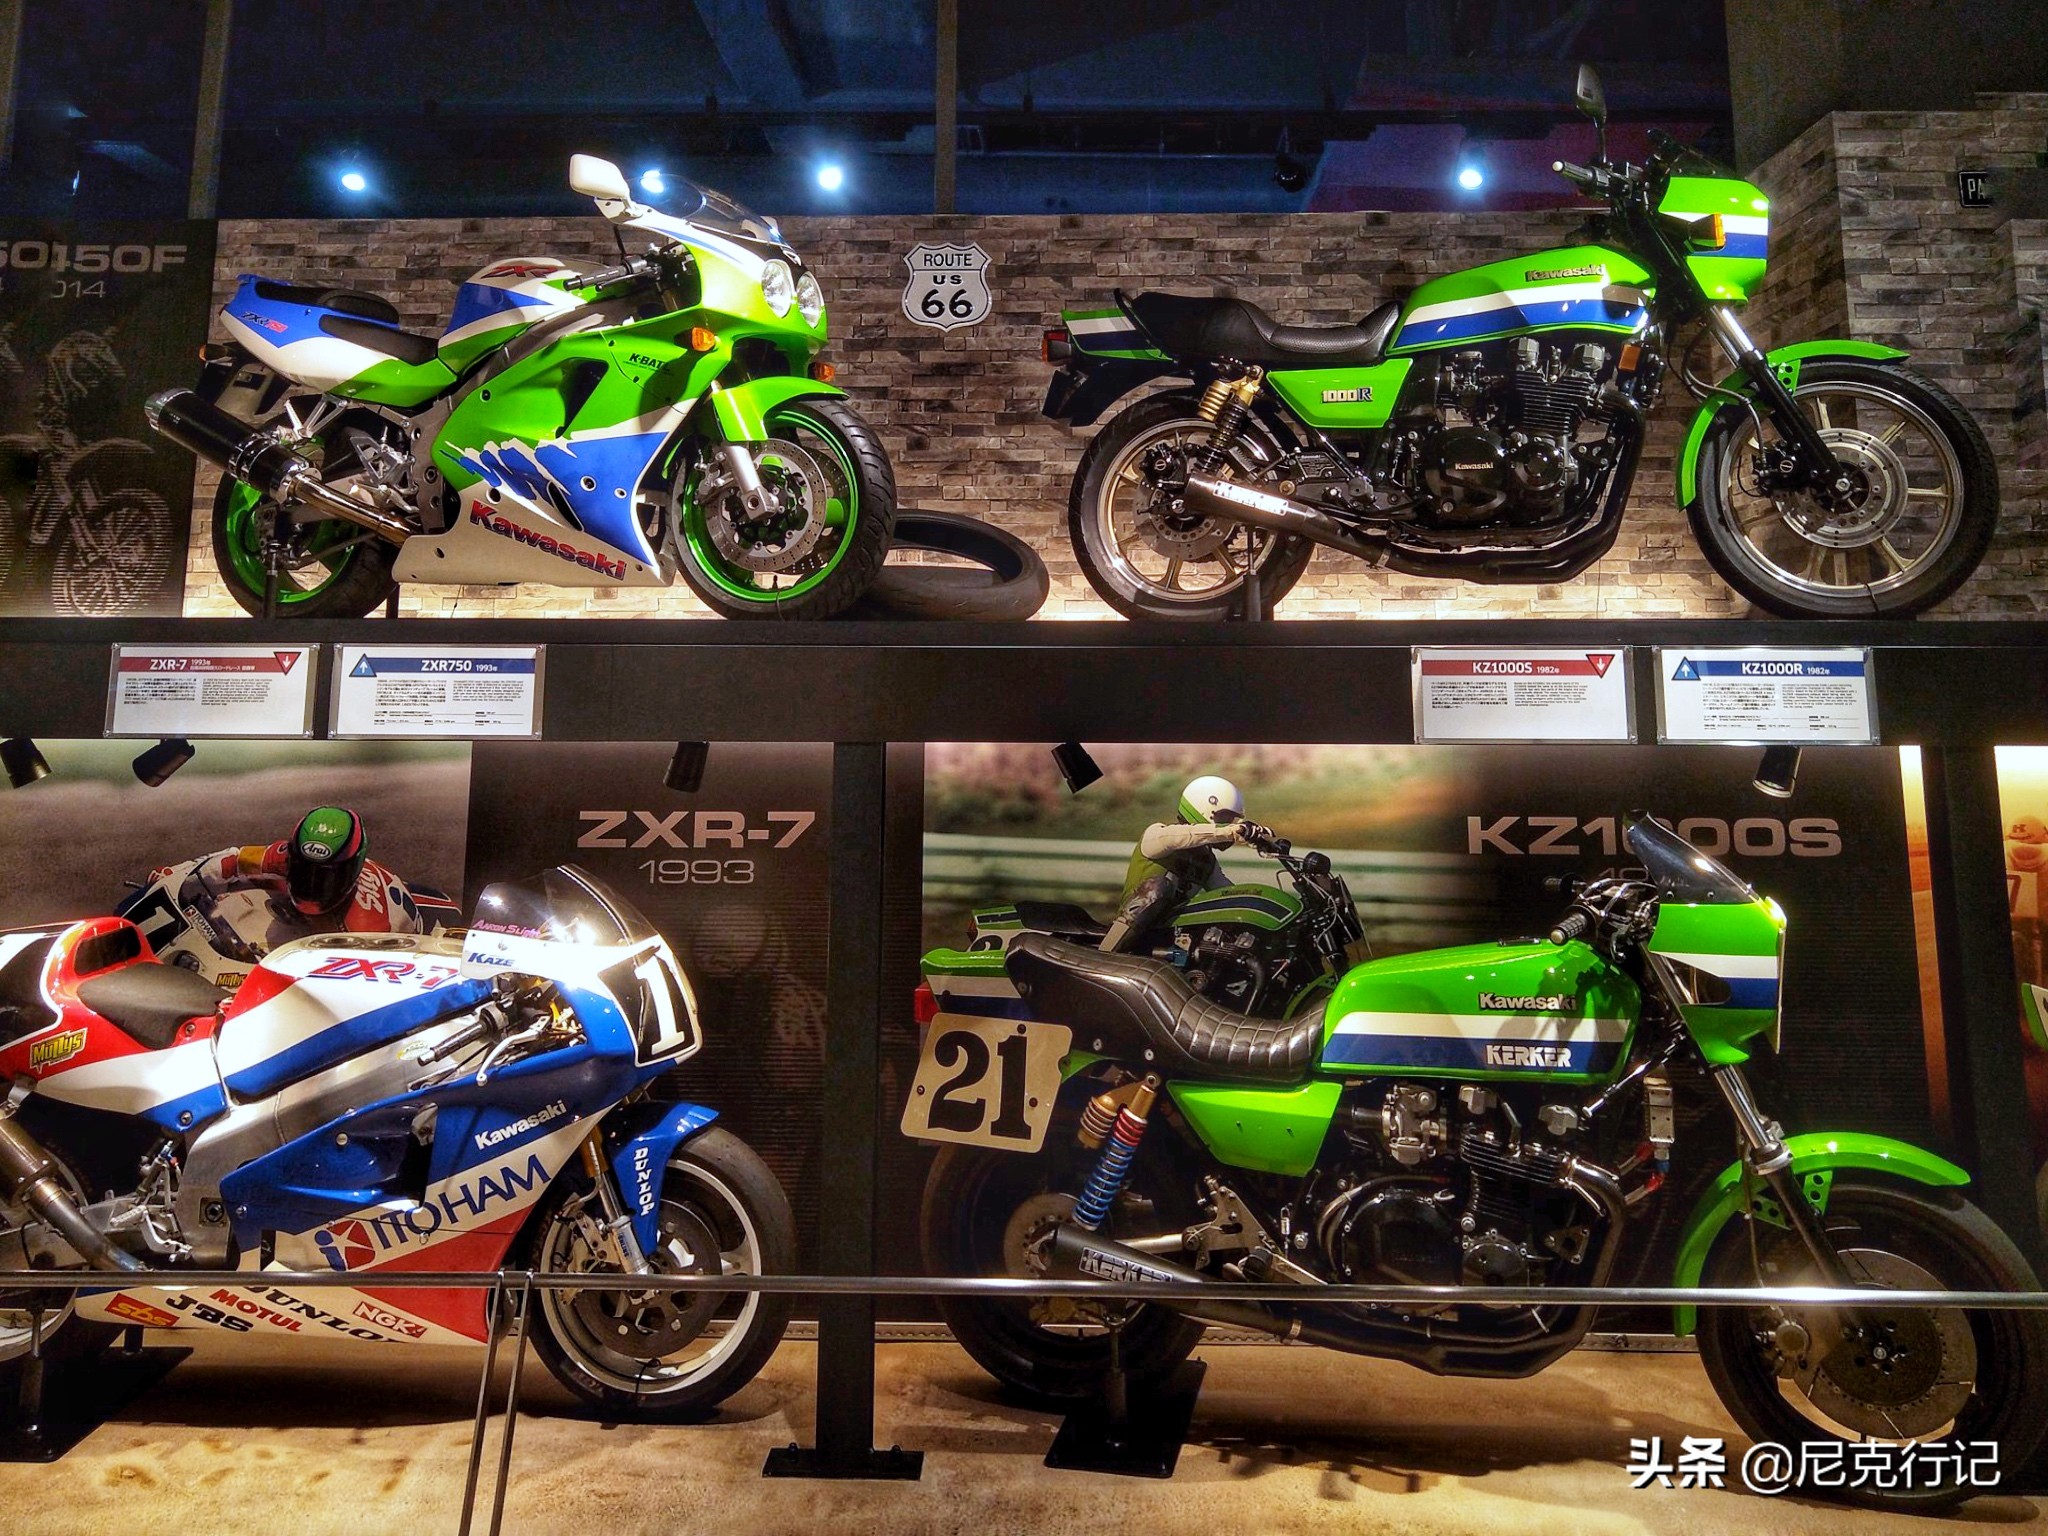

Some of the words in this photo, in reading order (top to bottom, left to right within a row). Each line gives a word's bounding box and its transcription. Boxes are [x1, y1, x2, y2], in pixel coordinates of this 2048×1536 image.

[923, 253, 973, 267] ROUTE
[1526, 264, 1606, 282] Kawasaki
[921, 288, 974, 319] 66
[1322, 387, 1372, 403] 1000R
[1454, 462, 1494, 471] Kawasaki
[470, 500, 627, 581] Kawasaki
[150, 659, 188, 671] ZXR-7
[421, 660, 472, 672] ZXR750
[1472, 662, 1533, 674] KZ1000S
[1741, 662, 1803, 675] KZ1000R
[577, 811, 816, 848] ZXR-7
[302, 844, 330, 856] Arai
[638, 860, 755, 884] 1993
[467, 952, 515, 967] KAZE
[634, 954, 685, 1056] 1
[1479, 992, 1577, 1010] Kawasaki
[1486, 1044, 1572, 1068] KERKER
[927, 1030, 1032, 1140] 21
[475, 1100, 567, 1150] Kawasaki
[634, 1147, 655, 1216] DUNLOP
[370, 1154, 551, 1250] ITOHAM
[166, 1294, 254, 1332] JBS
[209, 1288, 303, 1332] MOTUL
[244, 1286, 406, 1343] UNLO
[354, 1301, 415, 1335] NGK
